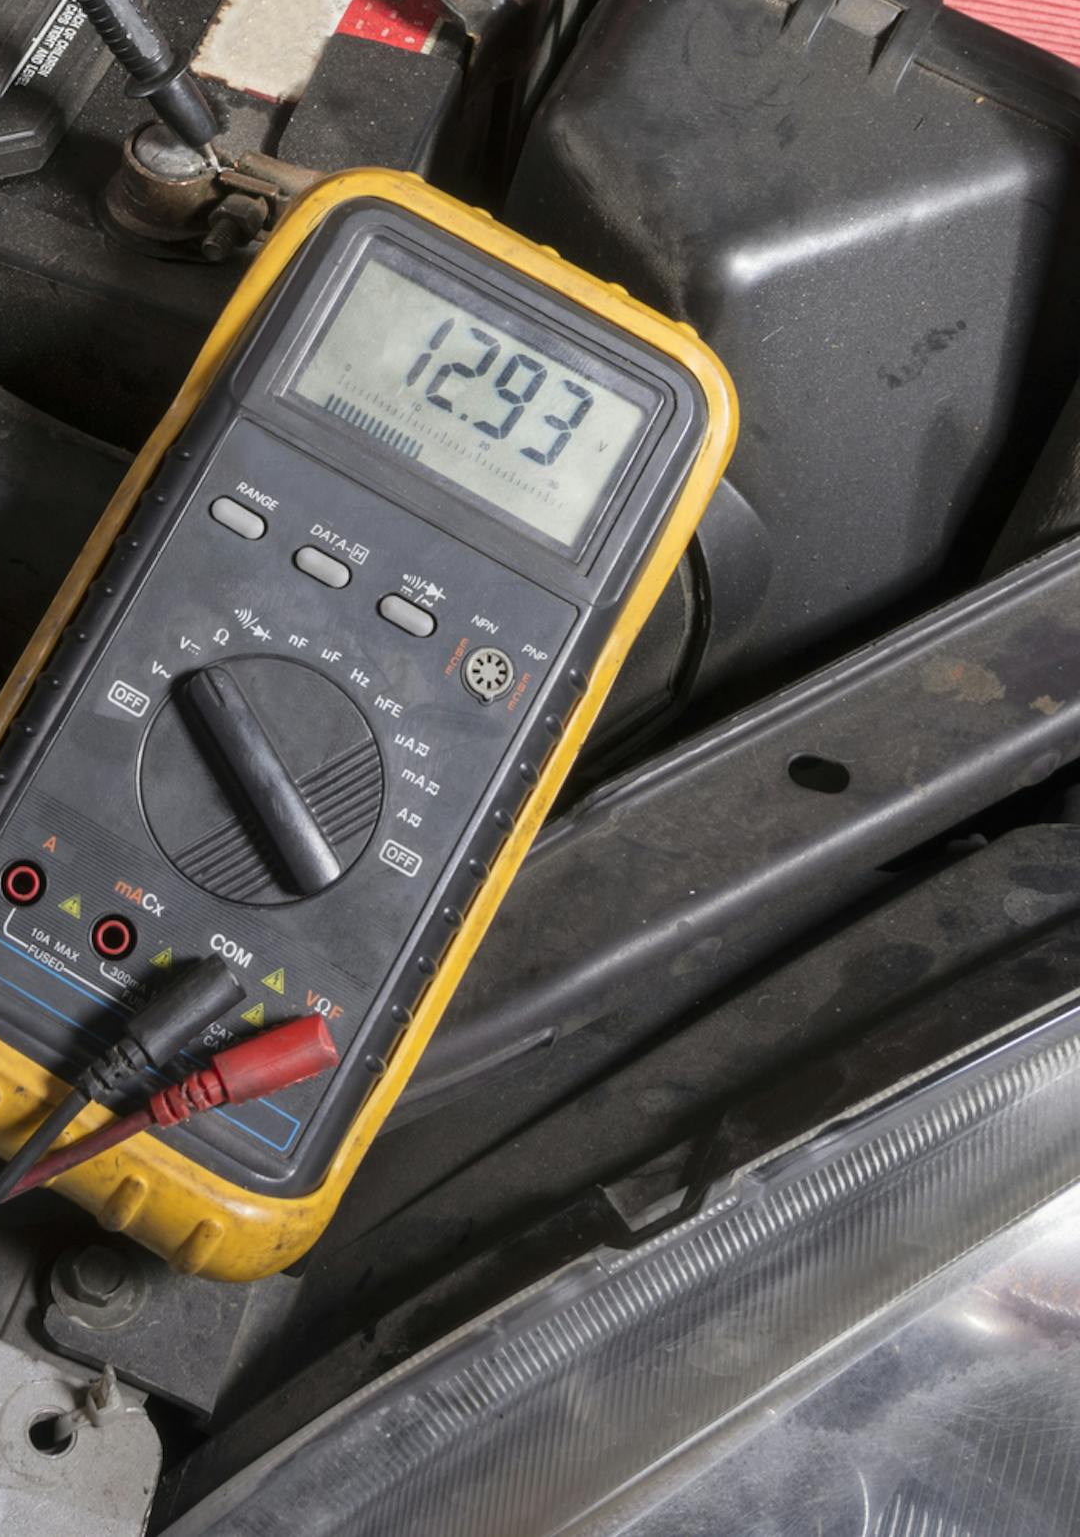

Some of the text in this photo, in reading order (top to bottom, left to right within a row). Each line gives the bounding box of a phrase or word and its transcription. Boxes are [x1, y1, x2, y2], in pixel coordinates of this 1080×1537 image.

[57, 3, 78, 25] CAPS
[42, 24, 65, 49] TIGHT
[62, 27, 77, 41] OF
[30, 46, 49, 65] AND
[37, 39, 69, 77] CHILDREN
[406, 317, 594, 466] 12.93
[236, 481, 280, 511] RANGE
[470, 614, 500, 635] NPN
[288, 634, 309, 649] nF
[521, 643, 549, 662] PNP
[349, 668, 370, 688] Hz
[115, 687, 144, 708] OFF
[374, 695, 404, 718] hFE
[42, 834, 57, 853] A
[385, 846, 416, 868] OFF
[31, 927, 80, 963] 10A MAX
[210, 933, 253, 969] COM
[27, 943, 65, 973] FUSED
